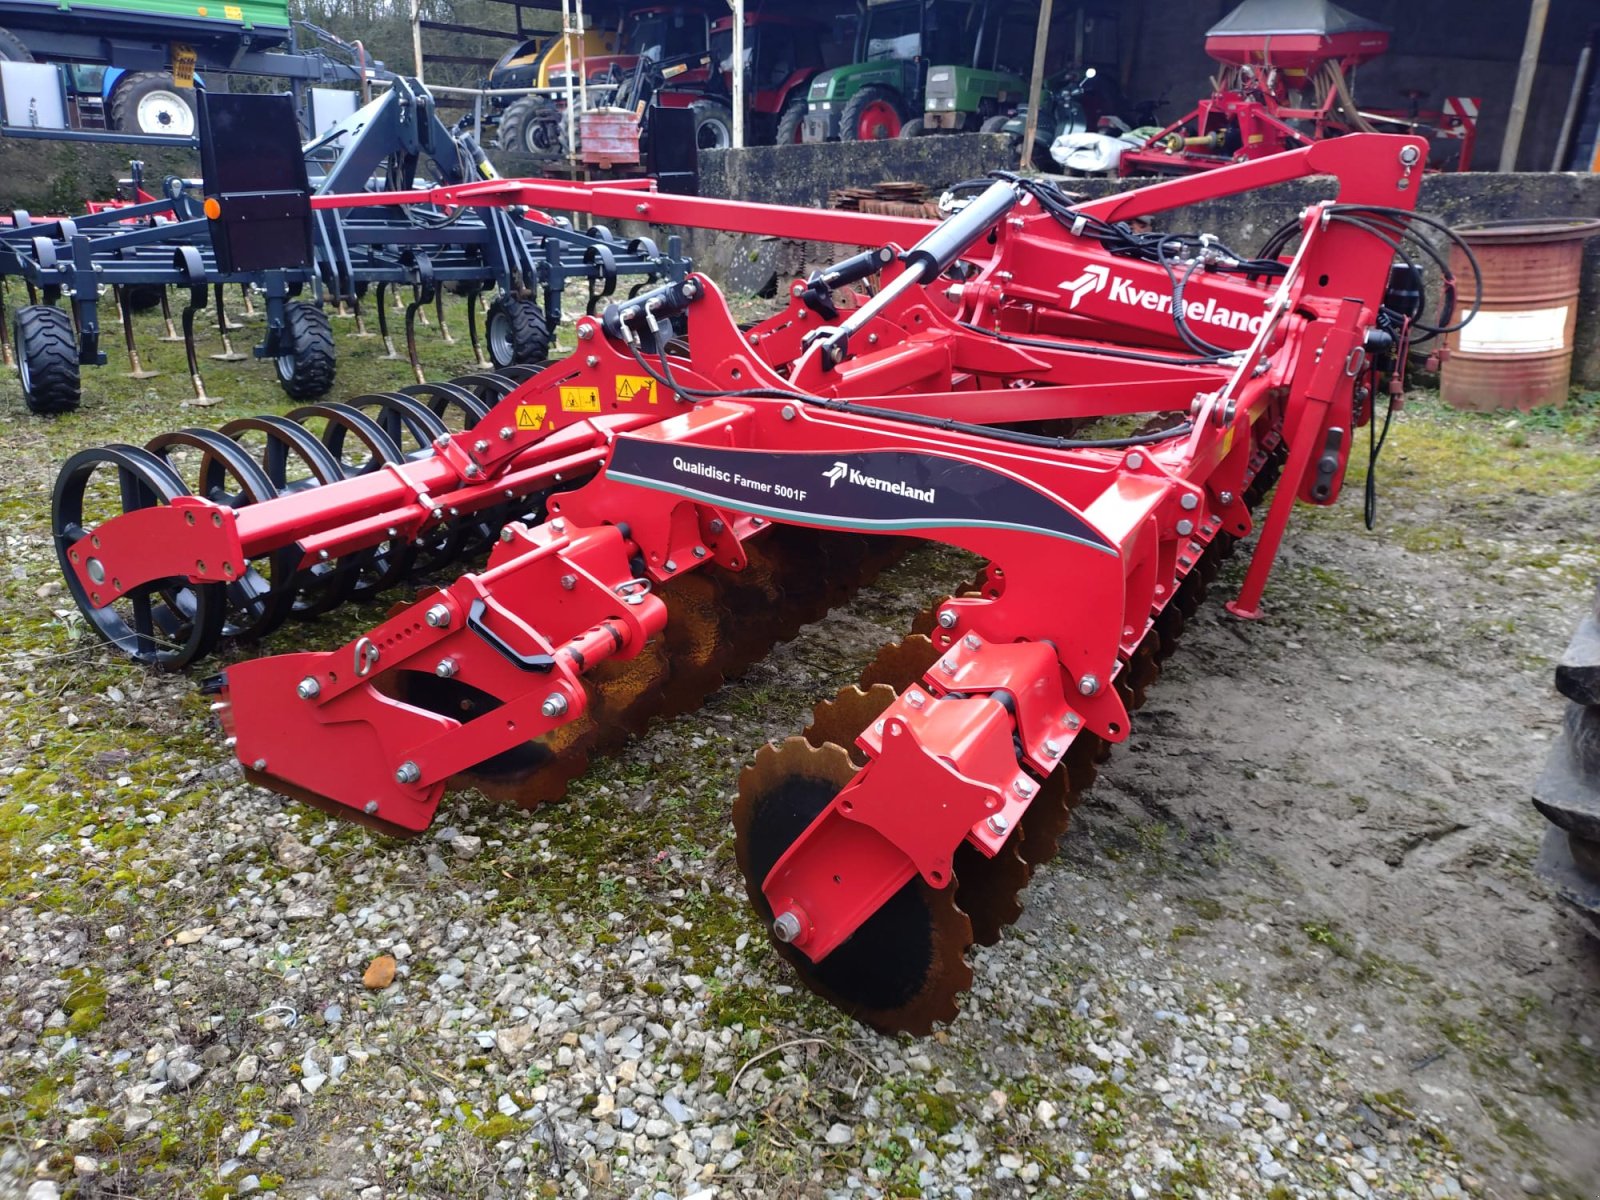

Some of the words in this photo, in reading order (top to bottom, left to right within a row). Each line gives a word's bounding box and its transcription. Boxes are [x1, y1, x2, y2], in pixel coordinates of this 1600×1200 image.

[672, 456, 731, 483] Qualidisc
[733, 473, 772, 493] Farmer
[774, 484, 807, 501] 5001F
[849, 468, 935, 504] Kverneland
